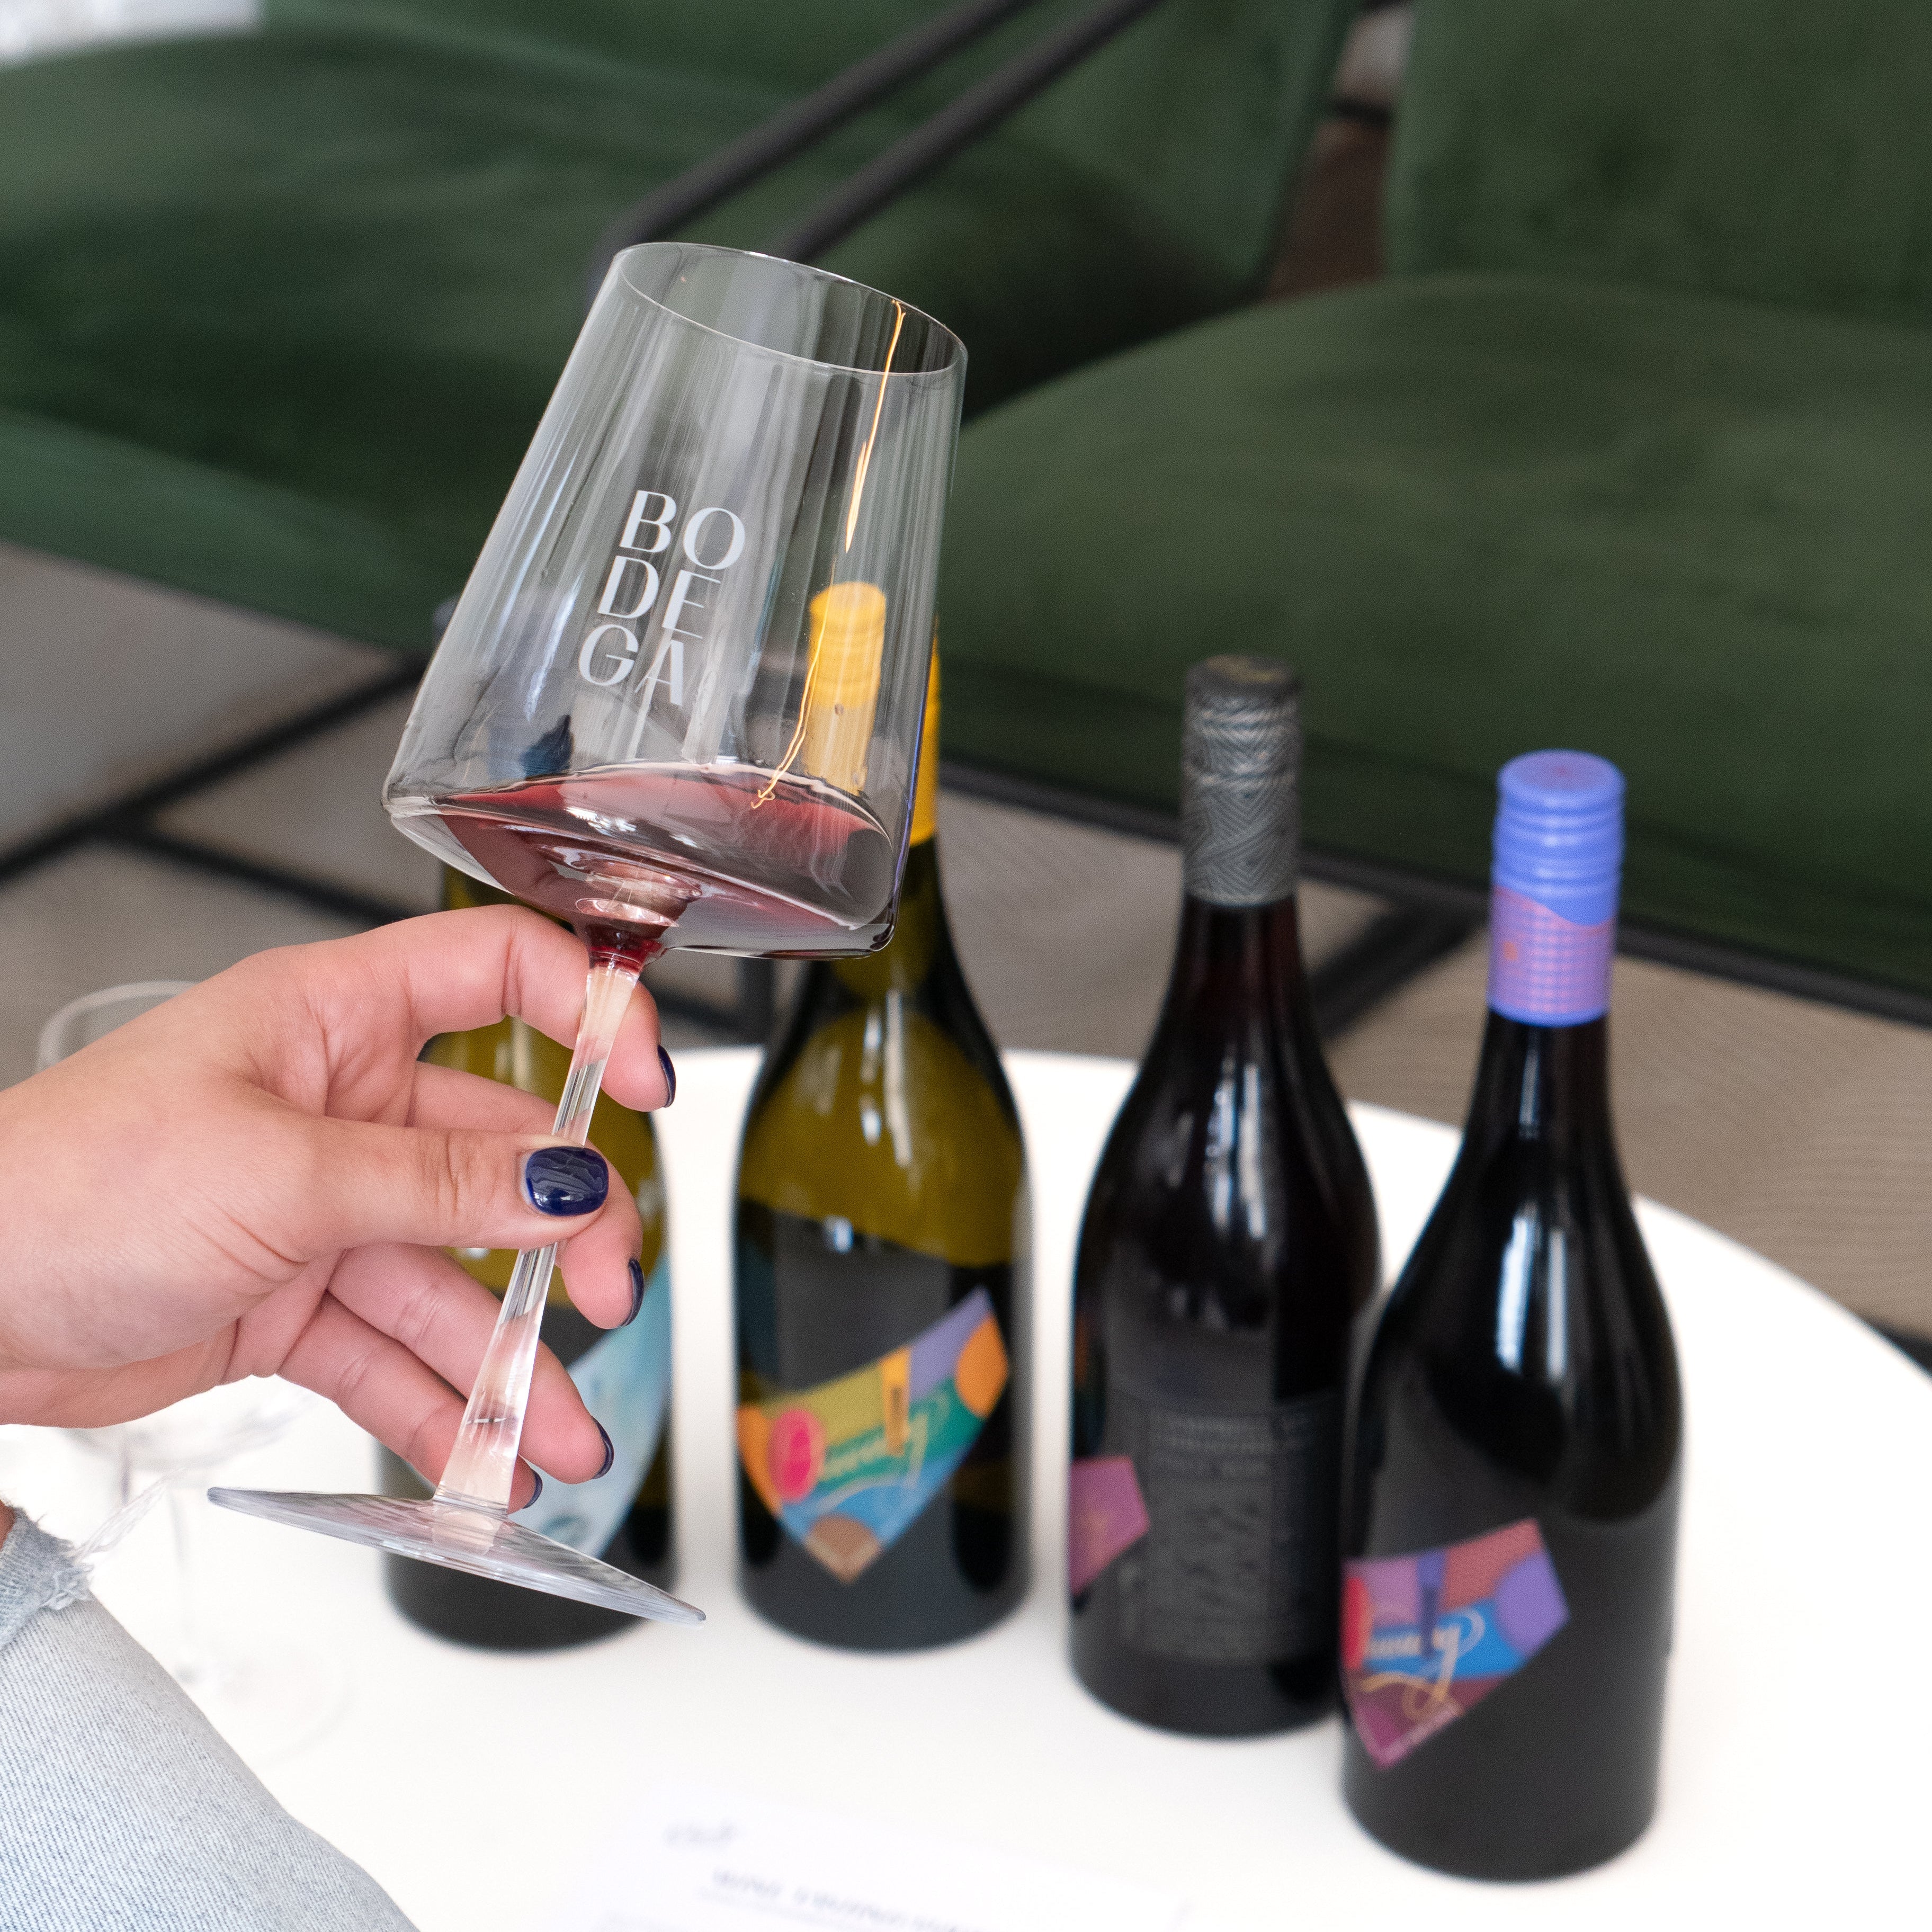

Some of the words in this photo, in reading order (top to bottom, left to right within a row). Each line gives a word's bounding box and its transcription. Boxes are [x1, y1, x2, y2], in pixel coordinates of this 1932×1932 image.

[620, 490, 745, 570] BO
[597, 555, 721, 639] DE
[578, 624, 684, 706] GA
